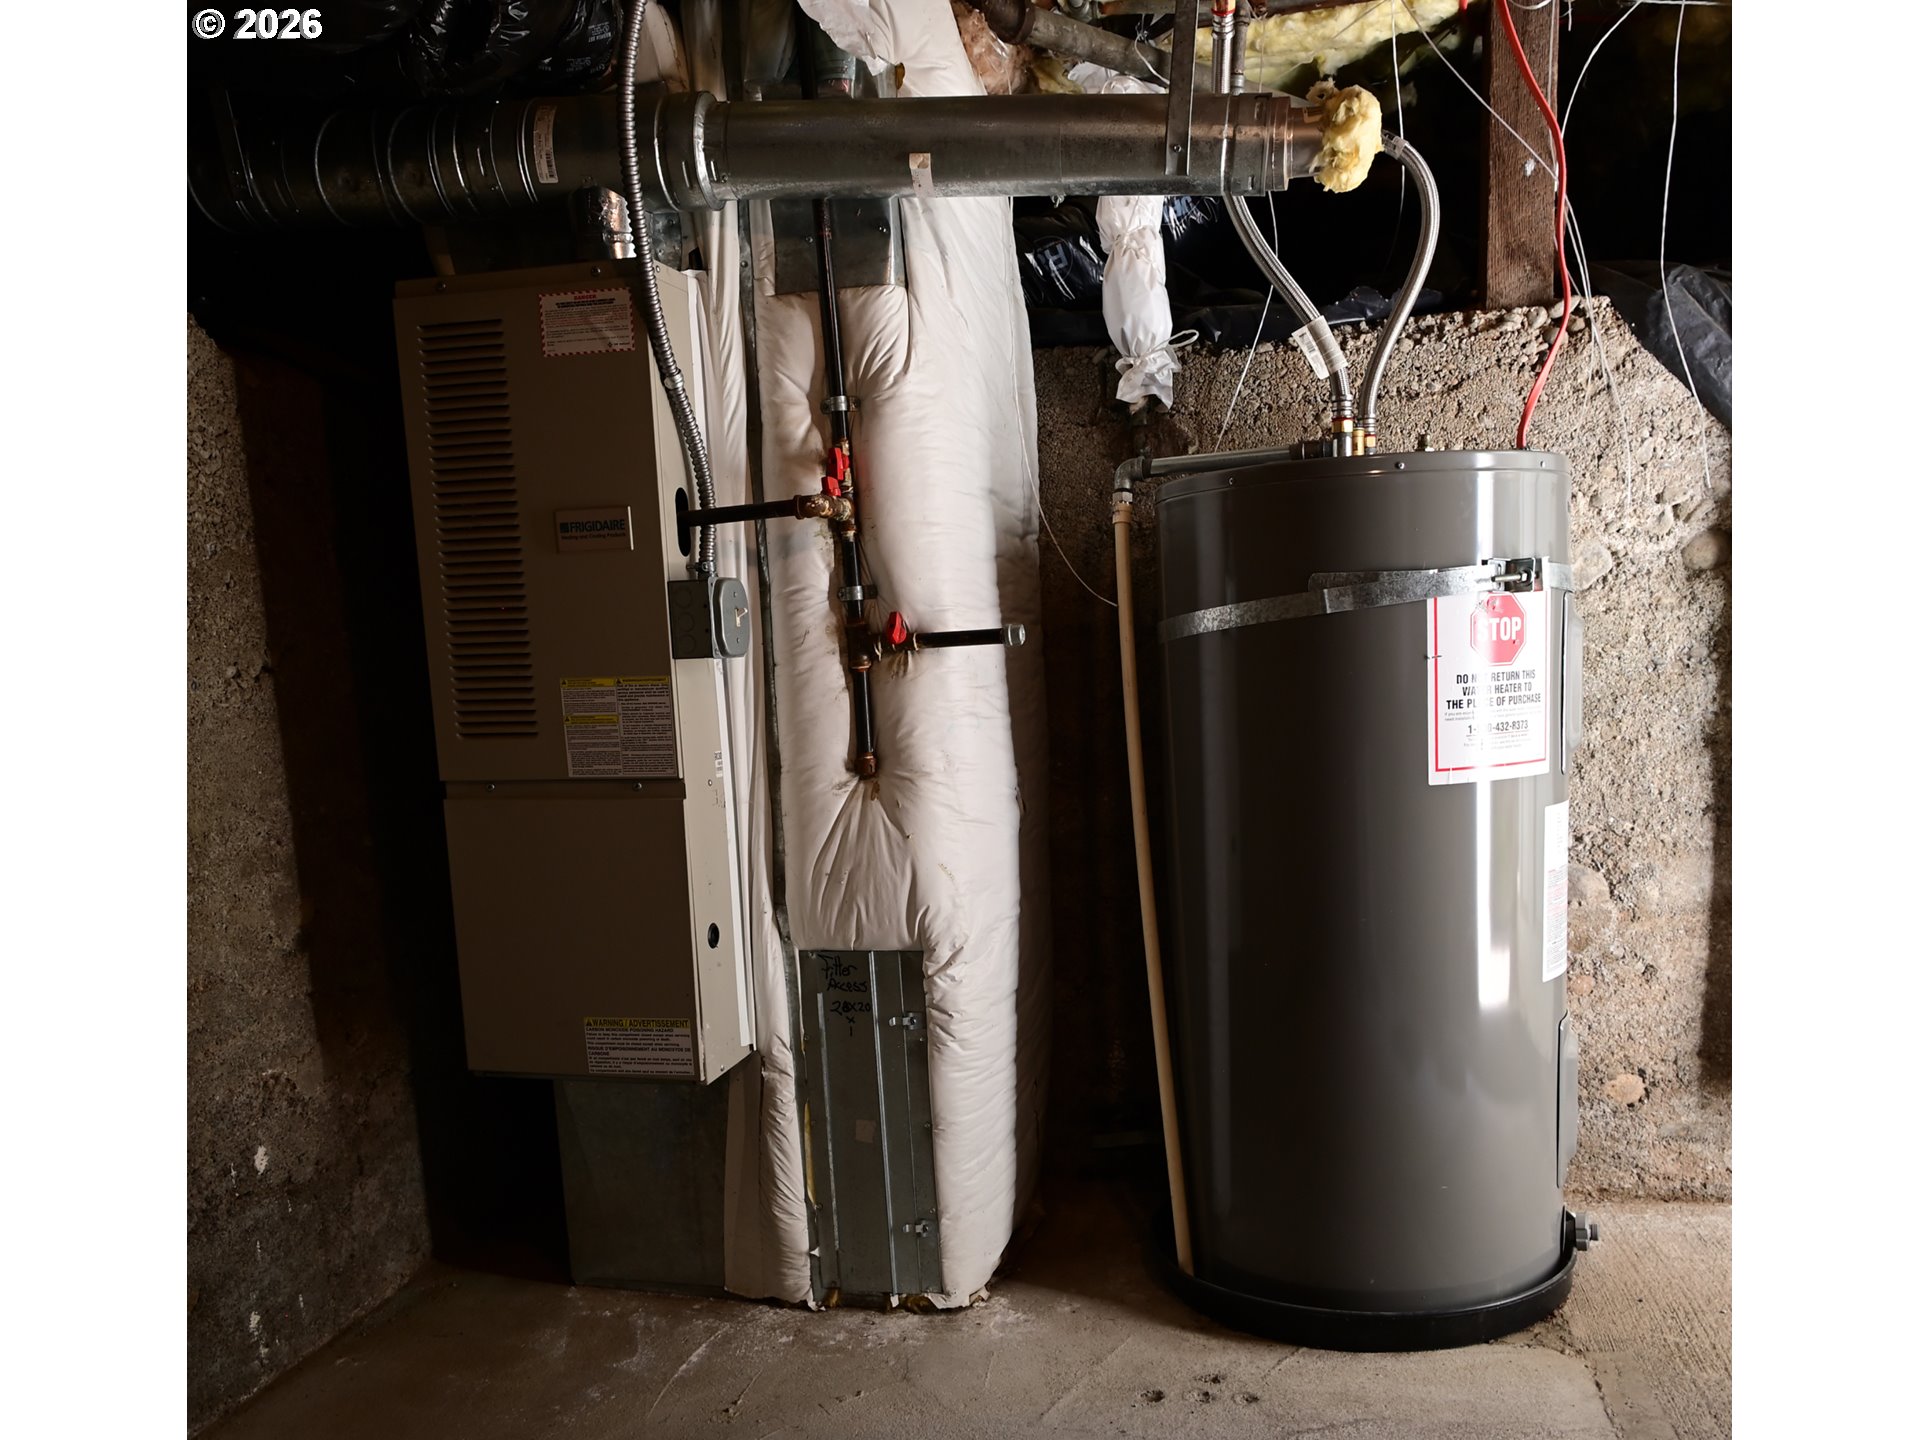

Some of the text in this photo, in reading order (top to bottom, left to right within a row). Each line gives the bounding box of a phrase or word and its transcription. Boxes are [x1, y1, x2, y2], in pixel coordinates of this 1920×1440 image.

[570, 519, 625, 532] FRIGIDAIRE
[1477, 616, 1521, 641] STOP
[1456, 673, 1469, 685] DO
[1490, 670, 1520, 682] RETURN
[1522, 668, 1536, 680] THIS
[1494, 682, 1522, 694] HEATER
[1524, 681, 1532, 692] TO
[1446, 693, 1542, 710] THE PLE OF PURCHASE
[817, 954, 858, 980] Filter
[593, 1019, 623, 1027] WARNING
